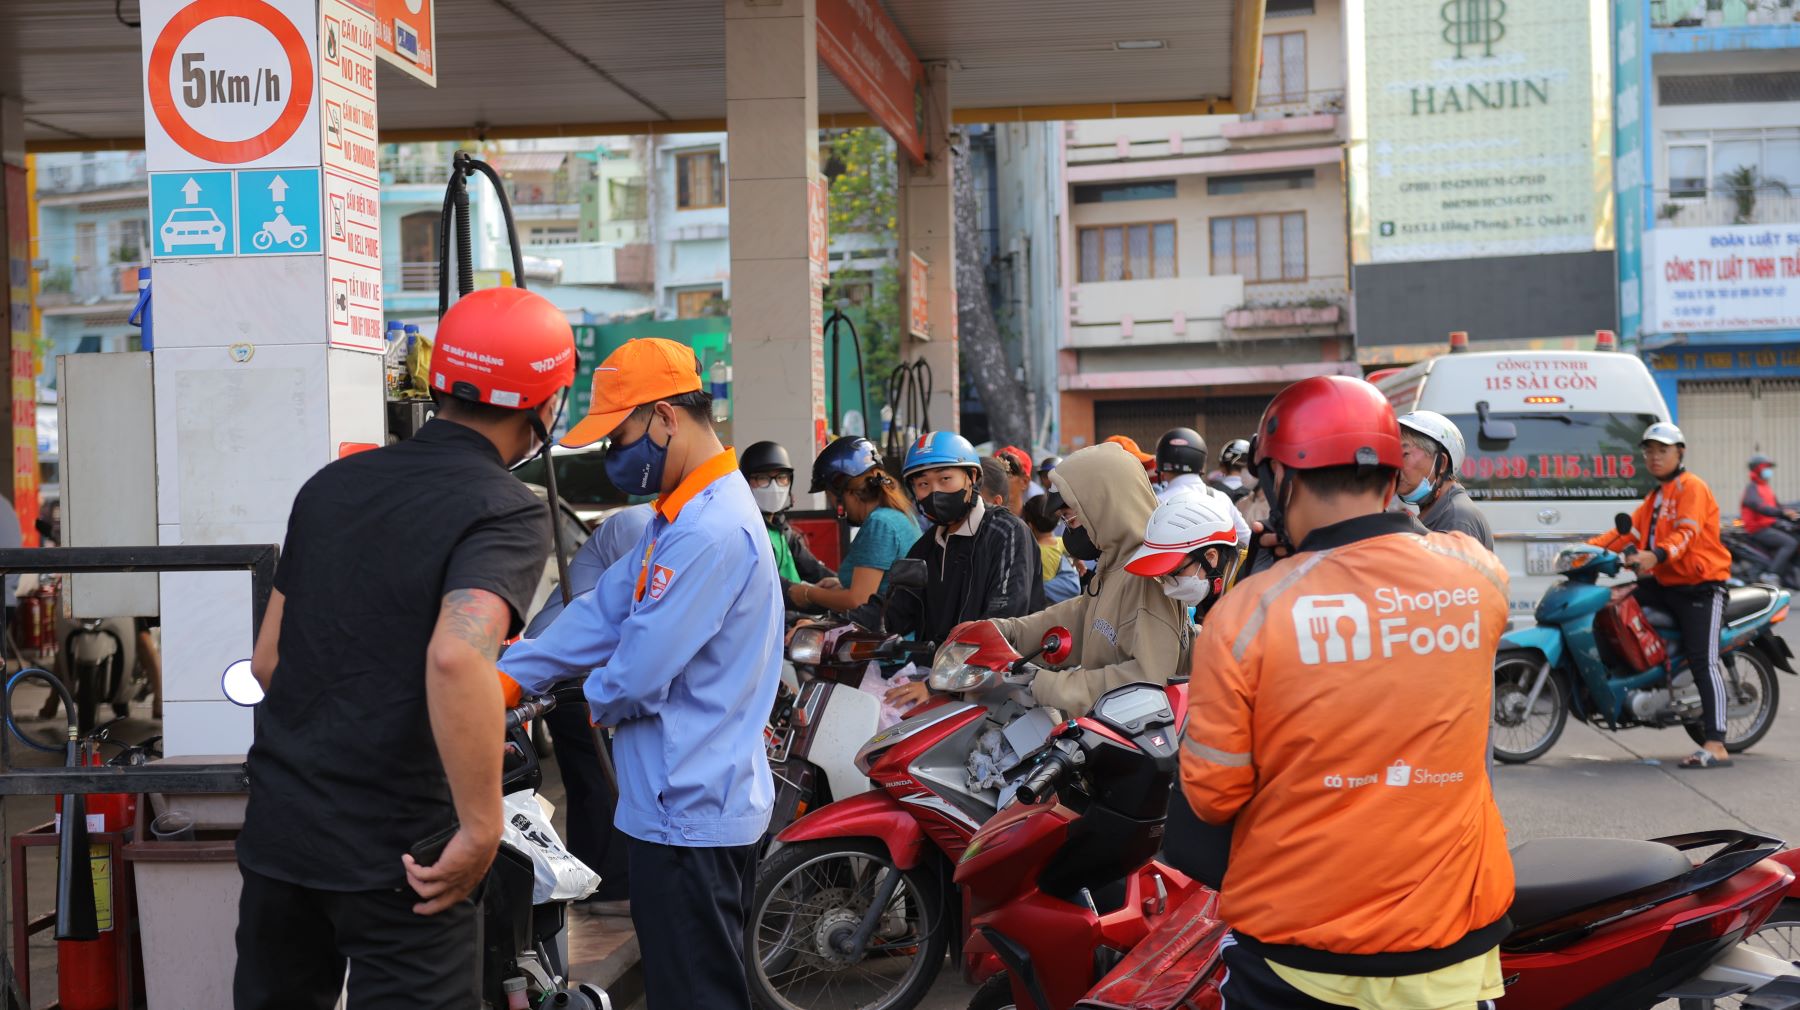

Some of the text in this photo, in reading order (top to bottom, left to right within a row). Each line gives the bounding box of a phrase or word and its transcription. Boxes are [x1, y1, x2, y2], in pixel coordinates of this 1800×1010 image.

[342, 18, 372, 50] CẤM LỬA
[182, 53, 280, 108] 5Km/h
[342, 56, 372, 90] NO FIRE
[1410, 77, 1550, 116] HANJIN
[342, 100, 374, 130] CẤM HÚT THUỐC
[344, 142, 376, 169] NO SMOKING
[346, 188, 377, 222] CẤM ĐIỆN THOẠI
[347, 232, 378, 258] NO CELL PHONE
[1710, 232, 1744, 248] ĐOÀN
[1749, 231, 1781, 248] LUẬT
[1665, 255, 1696, 282] CÔNG
[1699, 258, 1712, 282] TY
[1717, 254, 1744, 284] LUẬT
[1748, 257, 1776, 279] TNHH
[349, 272, 380, 302] TẮT MÁY XE
[1496, 358, 1588, 370] CÔNG TY TNHH
[1485, 372, 1597, 390] 115 SÀI GÒN
[1462, 454, 1636, 479] 0939.115.115
[1374, 586, 1480, 616] Shopee
[1379, 610, 1480, 658] Food
[1324, 774, 1343, 788] CÓ
[1414, 768, 1464, 786] Shopee
